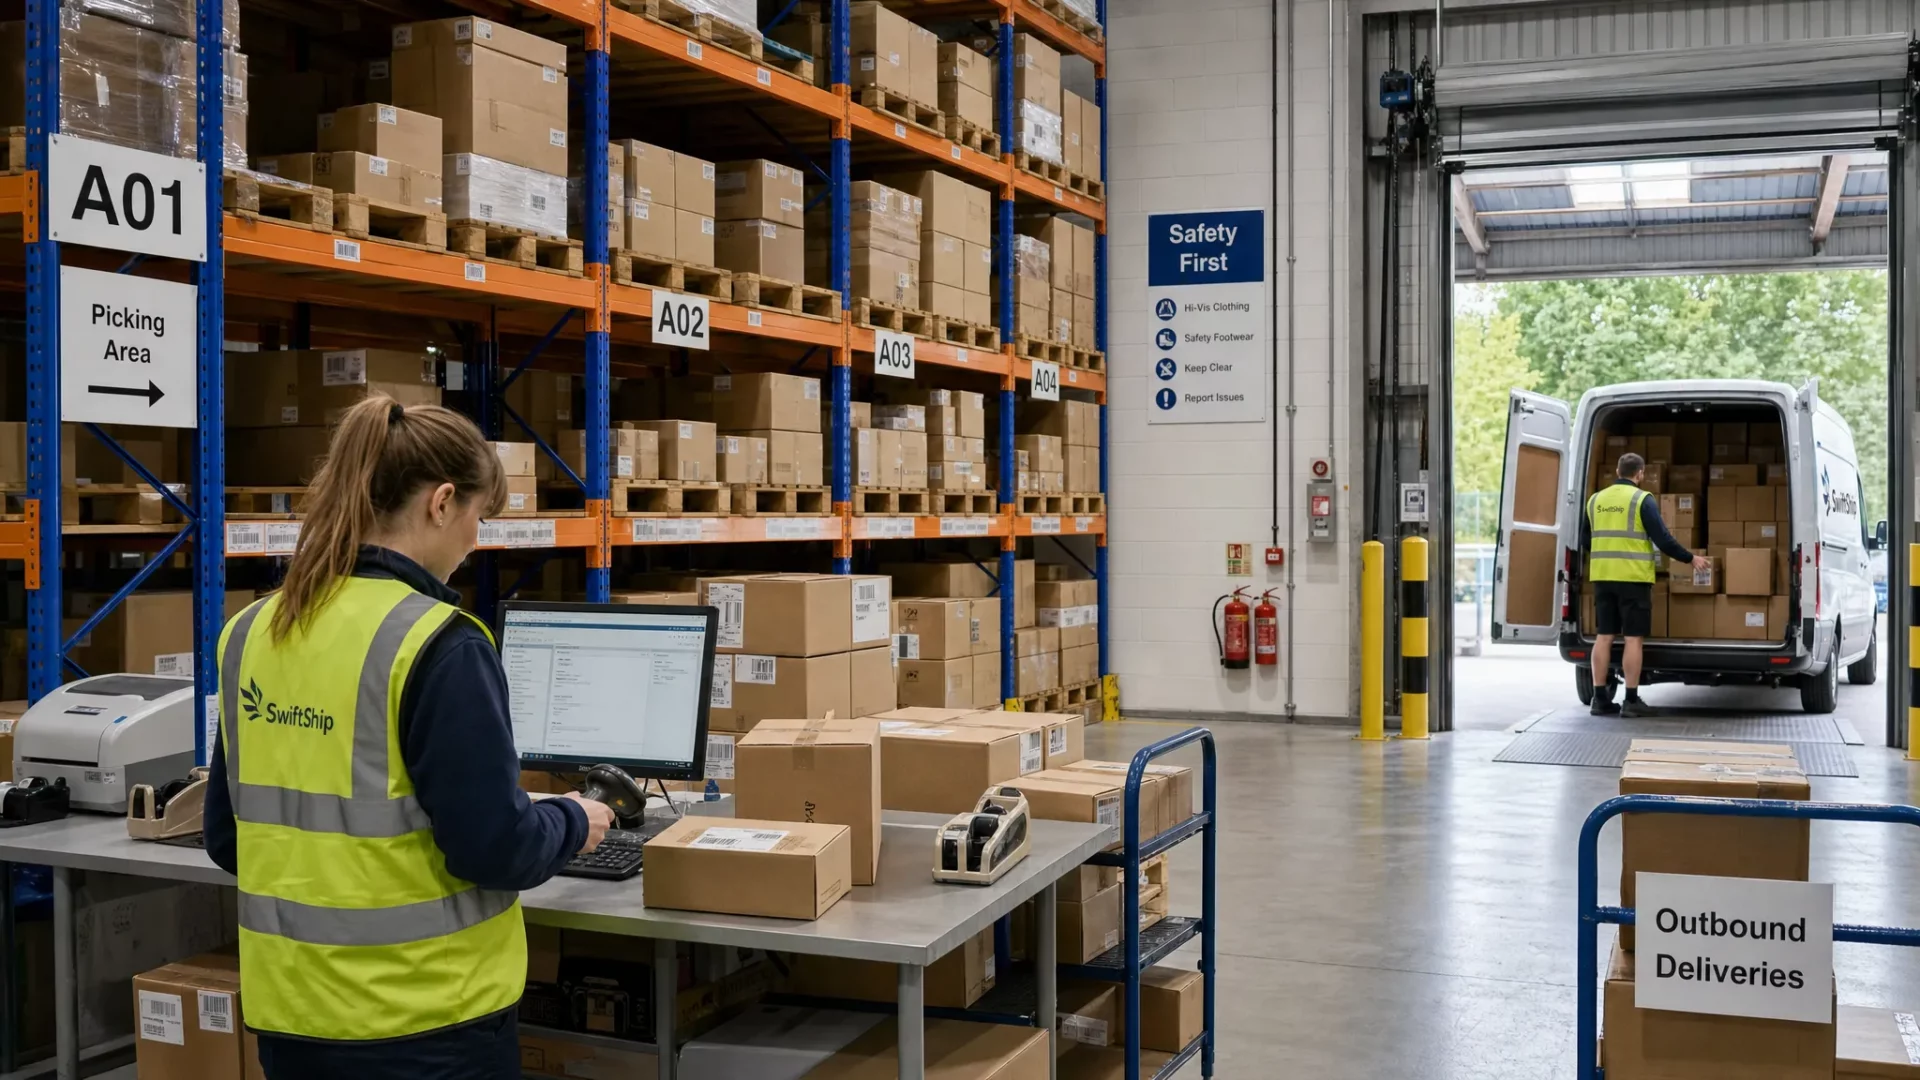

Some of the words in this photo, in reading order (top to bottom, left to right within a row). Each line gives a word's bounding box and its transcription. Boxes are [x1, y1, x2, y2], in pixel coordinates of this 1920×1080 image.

[72, 165, 182, 235] A01
[1169, 223, 1238, 246] Safety
[1180, 253, 1228, 272] First
[1184, 303, 1211, 312] Hi-Vis
[1213, 302, 1250, 313] Clothing
[92, 304, 165, 337] Picking
[658, 301, 704, 338] A02
[1184, 333, 1211, 344] Safety
[1214, 332, 1254, 342] Footwear
[103, 340, 151, 363] Area
[879, 336, 911, 370] A03
[1184, 363, 1207, 374] Keep
[1209, 363, 1233, 373] Clear
[1034, 373, 1057, 393] A04
[1184, 393, 1214, 404] Report
[1216, 392, 1245, 402] Issues
[265, 702, 334, 735] SwiftShip
[1655, 907, 1806, 943] Outbound
[1656, 953, 1805, 989] Deliveries
